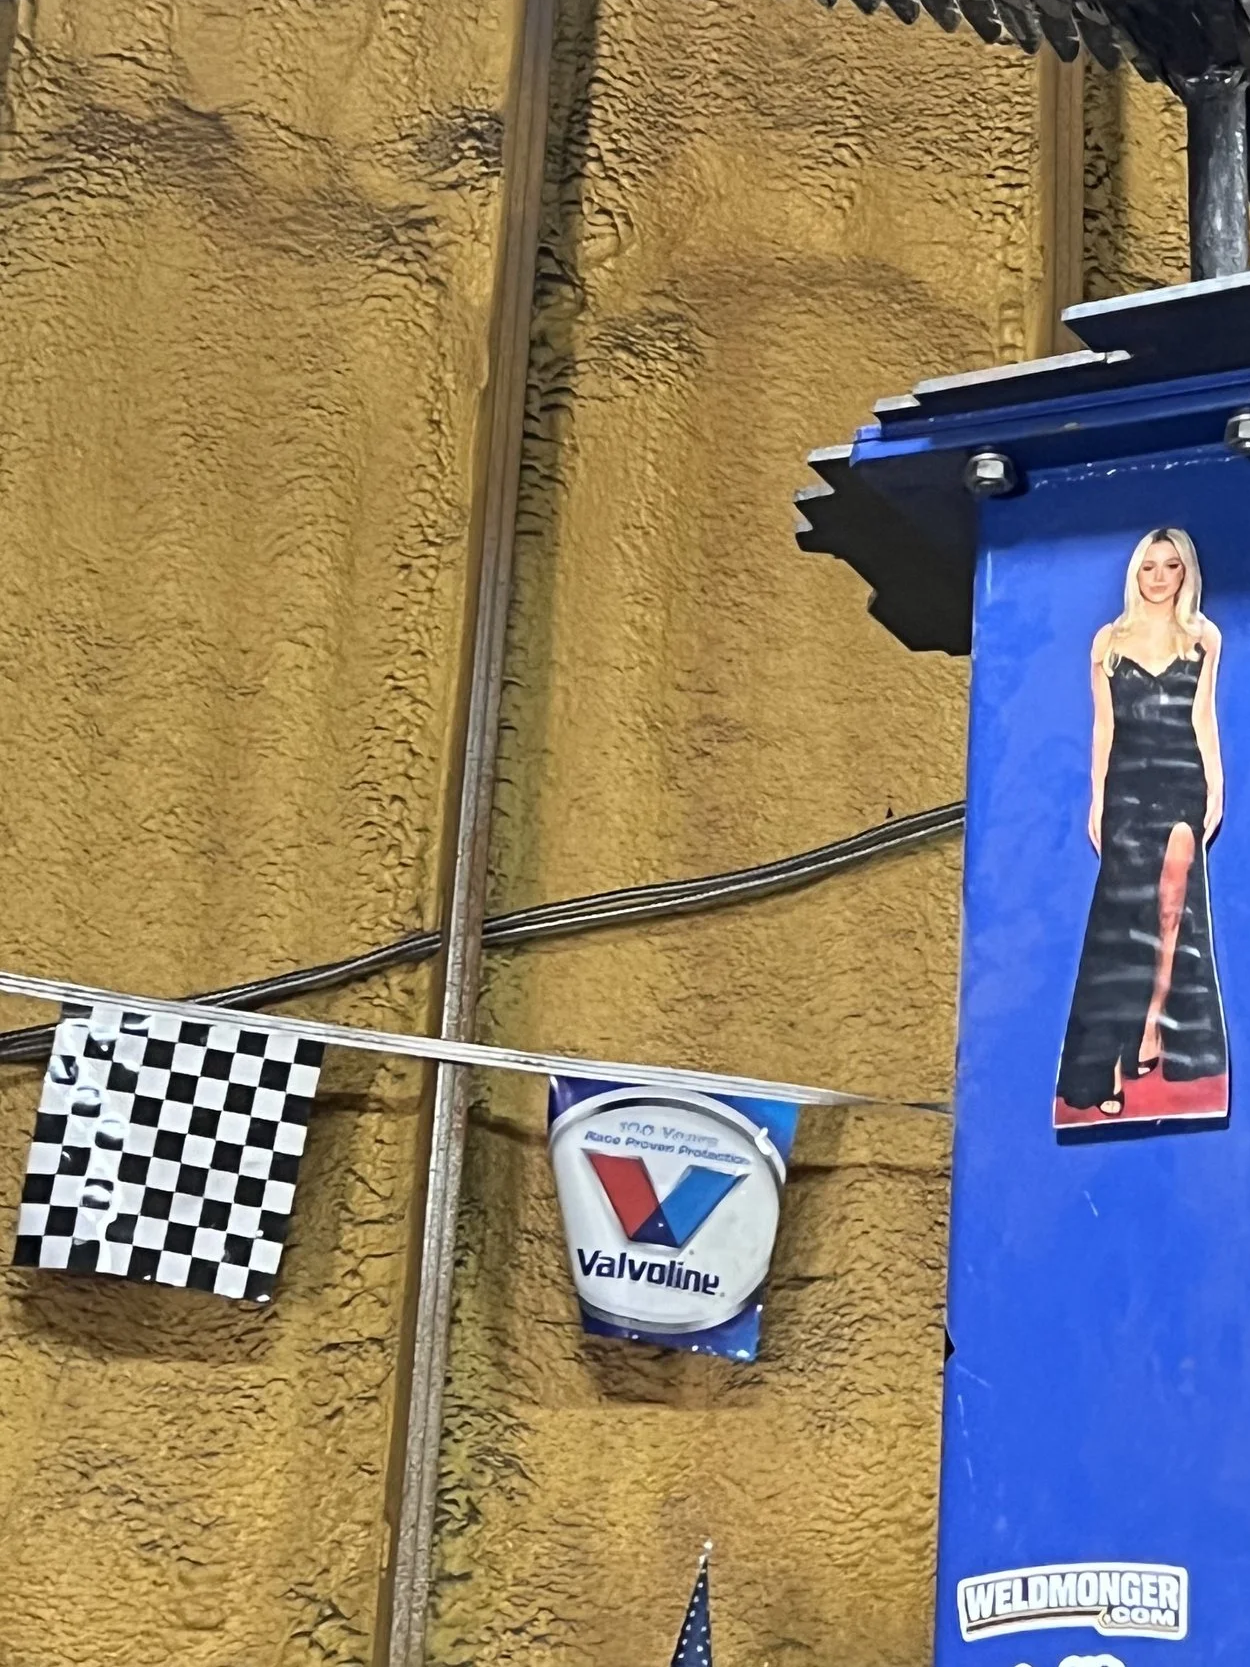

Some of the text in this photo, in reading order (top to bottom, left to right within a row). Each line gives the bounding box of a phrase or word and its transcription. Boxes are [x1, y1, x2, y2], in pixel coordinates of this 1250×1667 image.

[584, 1130, 751, 1165] Race Proven Protection
[577, 1248, 720, 1296] Valvoline
[965, 1571, 1180, 1623] WELDMONGER
[1103, 1605, 1177, 1627] .COM
